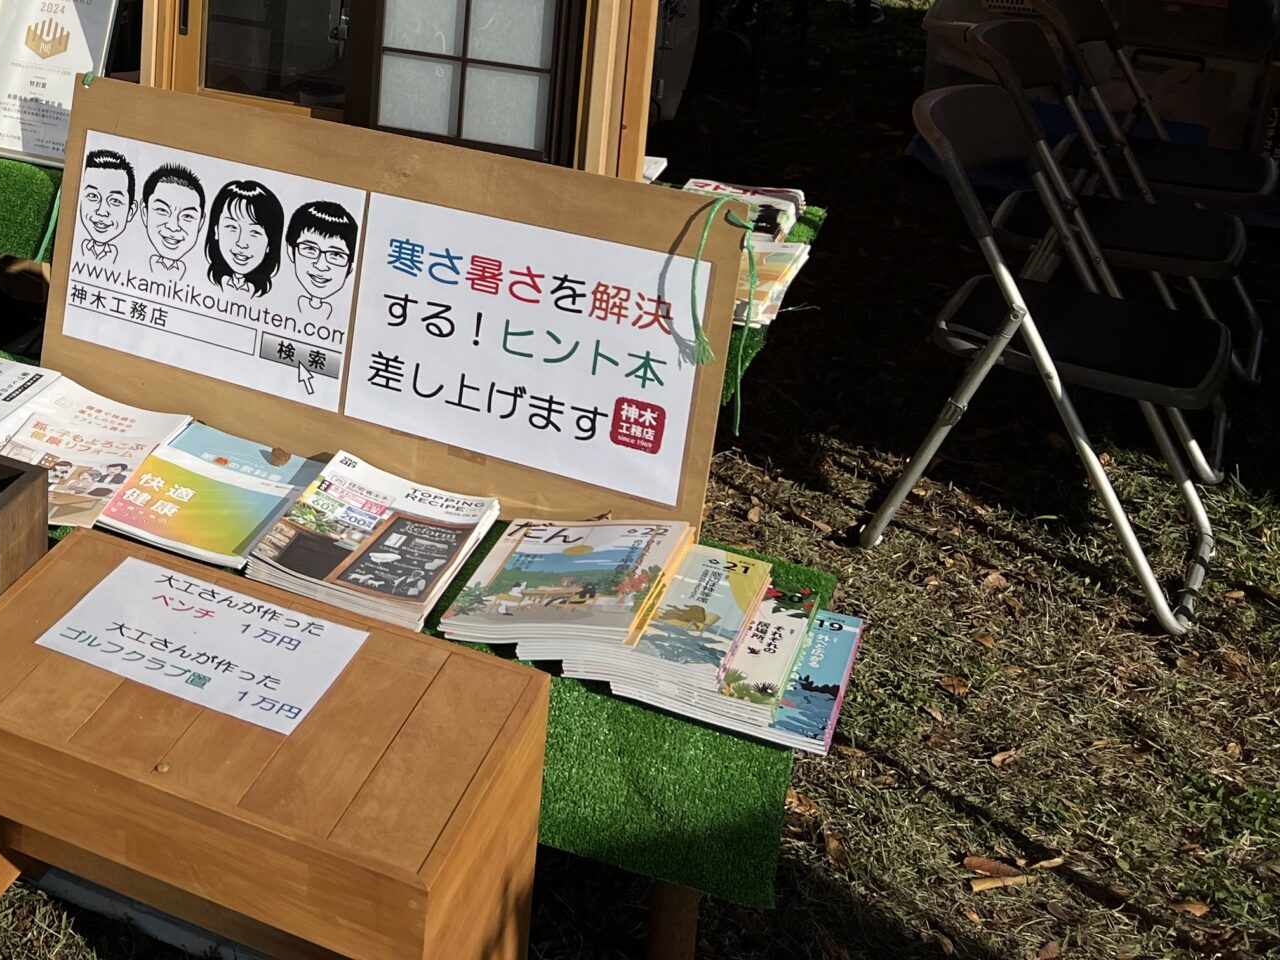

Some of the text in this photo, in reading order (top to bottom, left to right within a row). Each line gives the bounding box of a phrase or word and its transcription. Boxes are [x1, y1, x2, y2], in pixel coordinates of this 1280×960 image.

[40, 2, 65, 14] 2024
[387, 238, 675, 336] 寒さ暑さを解決
[70, 284, 168, 328] 神木工務店
[369, 350, 609, 441] 差し上げます
[621, 402, 658, 426] 神木
[618, 422, 656, 440] 工務店
[138, 472, 197, 504] 快適
[411, 487, 486, 508] TOPPING
[122, 487, 183, 518] 健康
[404, 493, 466, 513] RECIPE
[405, 521, 457, 545] Reform
[640, 527, 670, 537] 22
[723, 561, 751, 575] 21
[152, 593, 215, 620] ベンチ
[155, 574, 326, 637] 大工さんが作った
[816, 619, 844, 632] 19
[105, 621, 281, 691] 大工さんが作った
